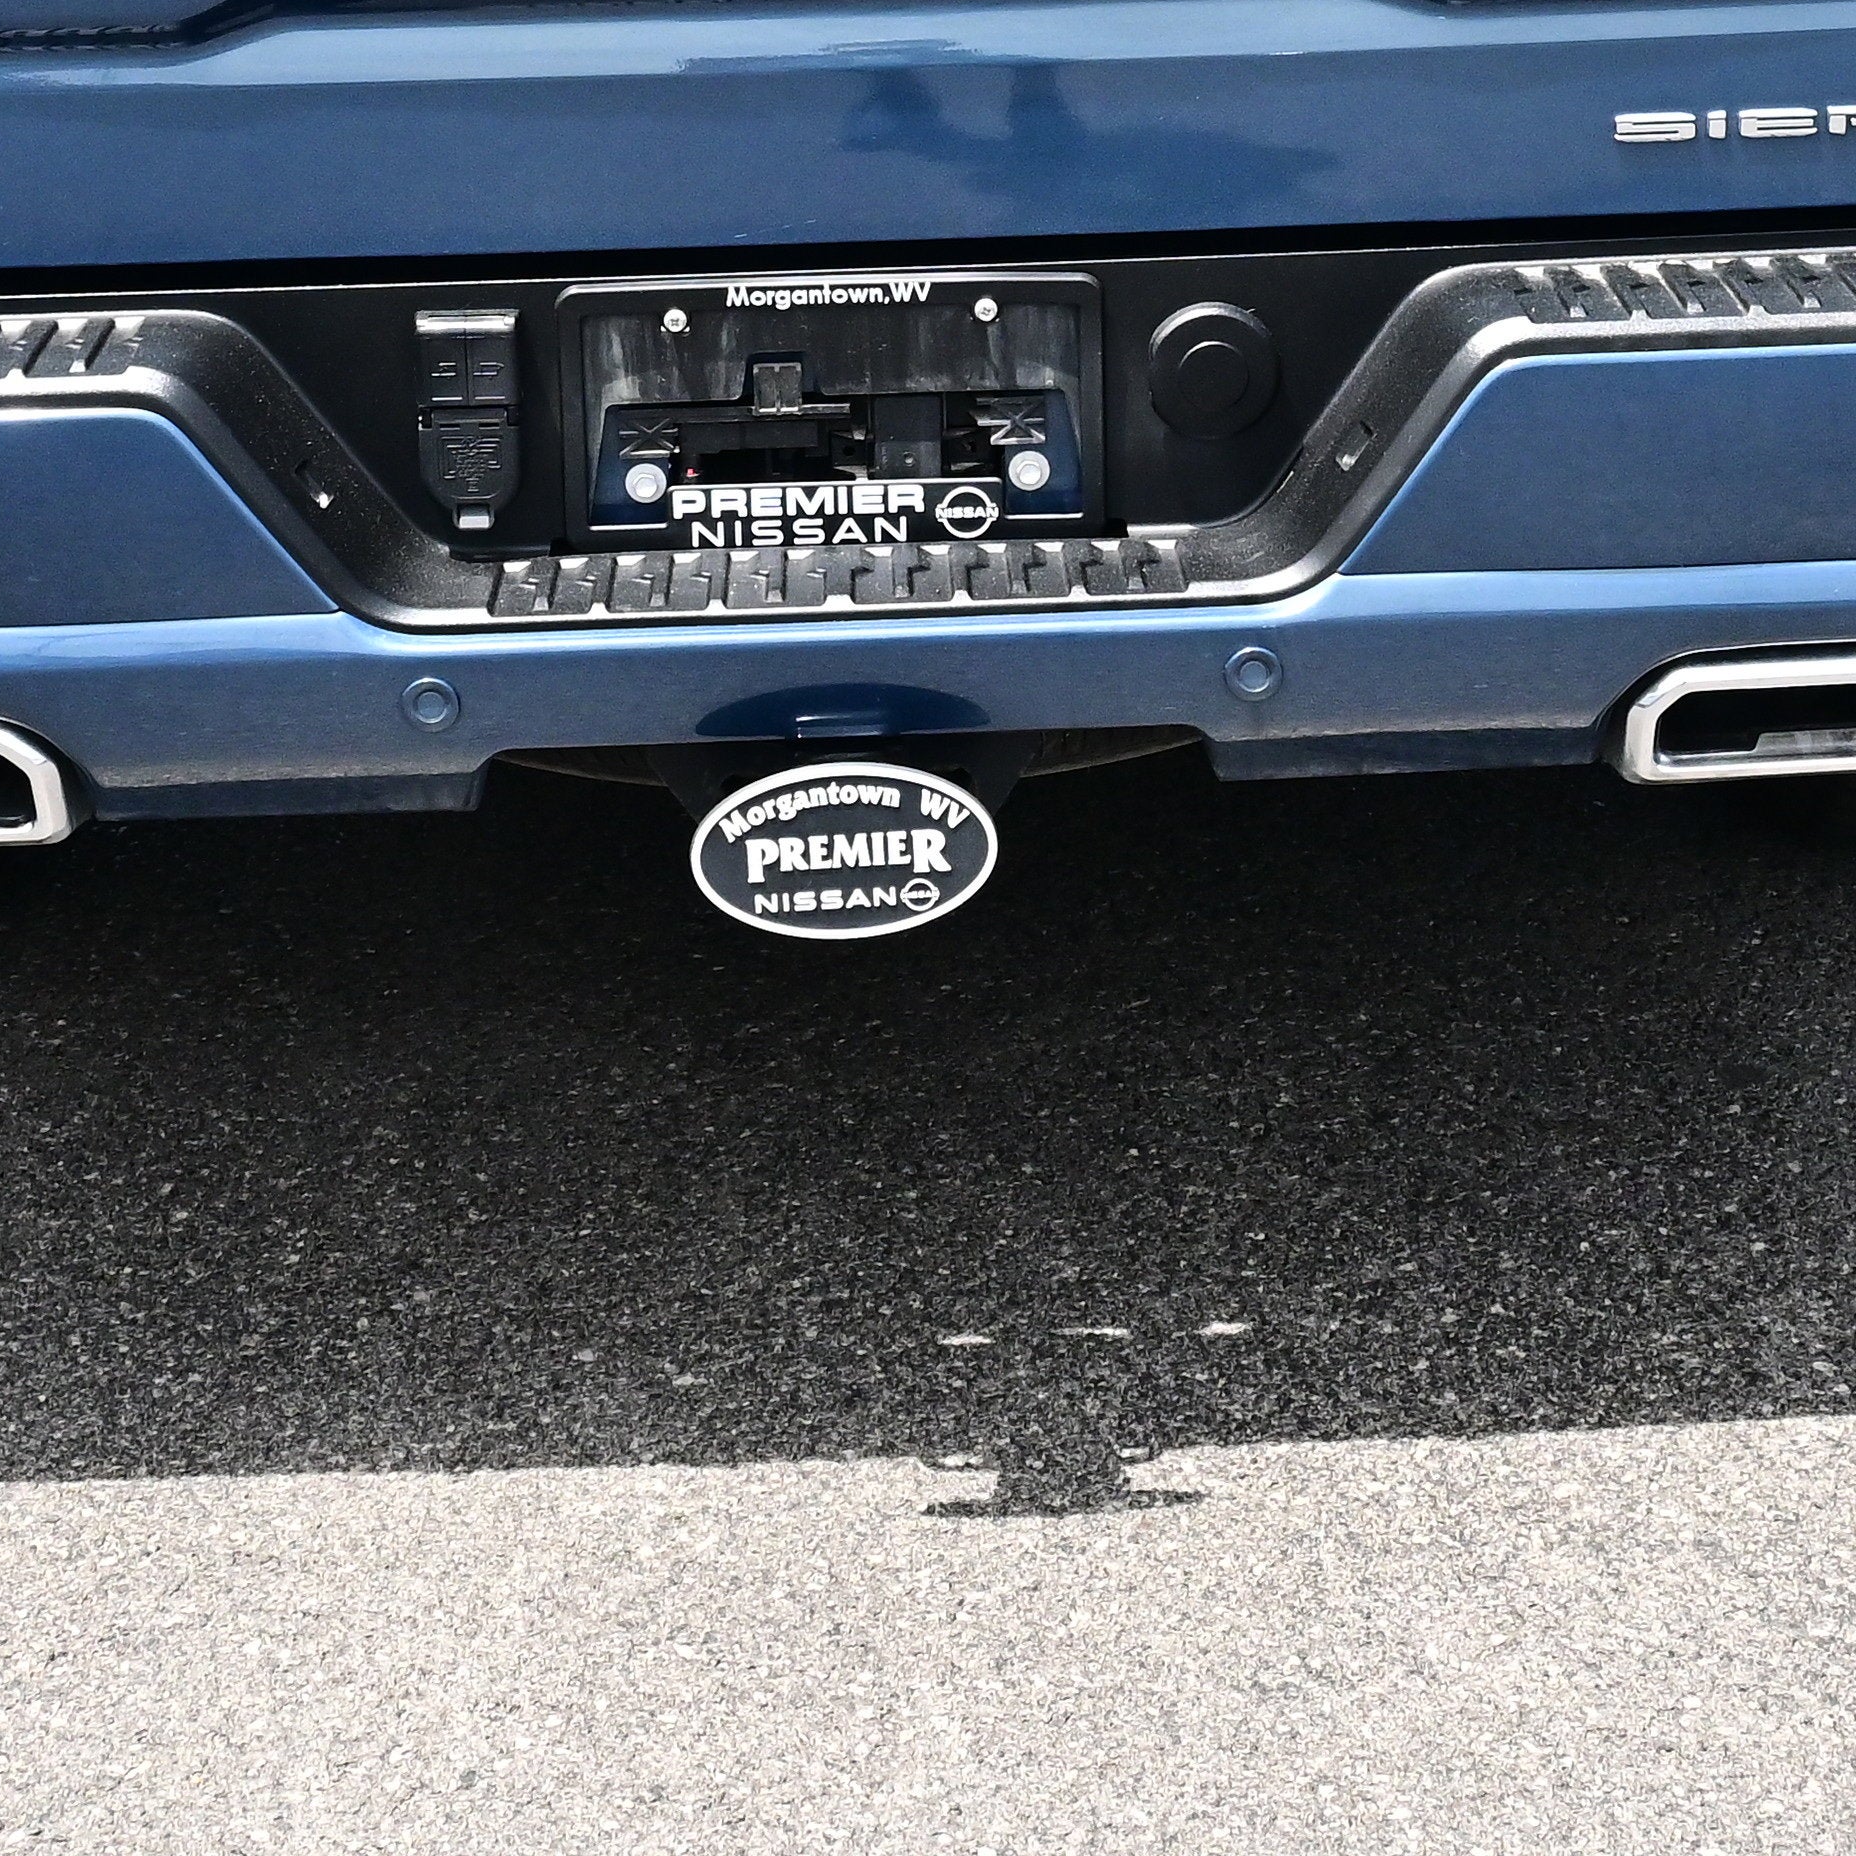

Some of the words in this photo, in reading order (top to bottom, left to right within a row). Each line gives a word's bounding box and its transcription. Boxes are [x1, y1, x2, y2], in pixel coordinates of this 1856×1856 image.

[672, 484, 925, 520] PREMIER
[935, 505, 1000, 520] NISSAN
[691, 515, 908, 548] NISSAN
[718, 781, 901, 844] Morgantown
[919, 788, 971, 830] WV
[745, 828, 952, 884] PREMIER
[754, 886, 897, 915] NISSAN
